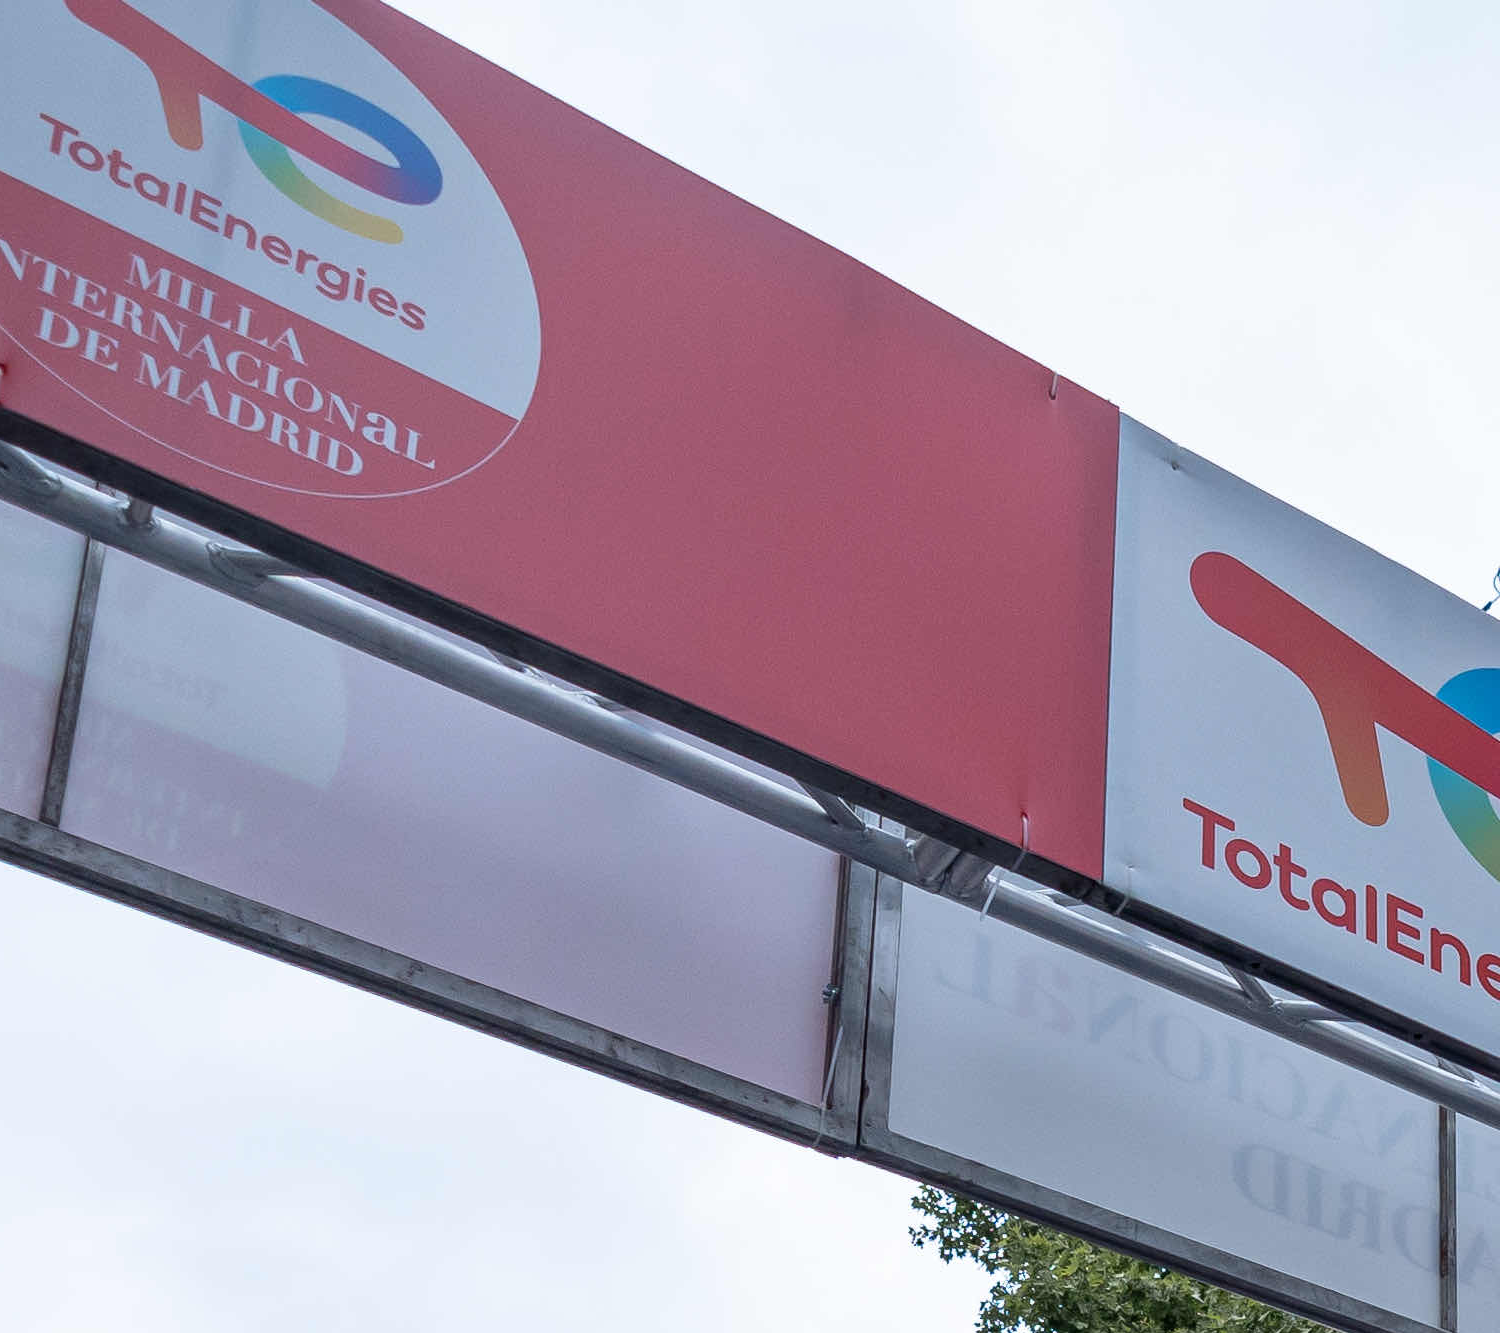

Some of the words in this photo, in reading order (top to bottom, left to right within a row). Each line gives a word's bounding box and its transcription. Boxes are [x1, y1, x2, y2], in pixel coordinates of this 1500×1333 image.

[39, 112, 427, 331] TotalEnergies
[35, 306, 118, 374] DE
[139, 354, 365, 479] MADRID
[127, 253, 308, 367] MILLA
